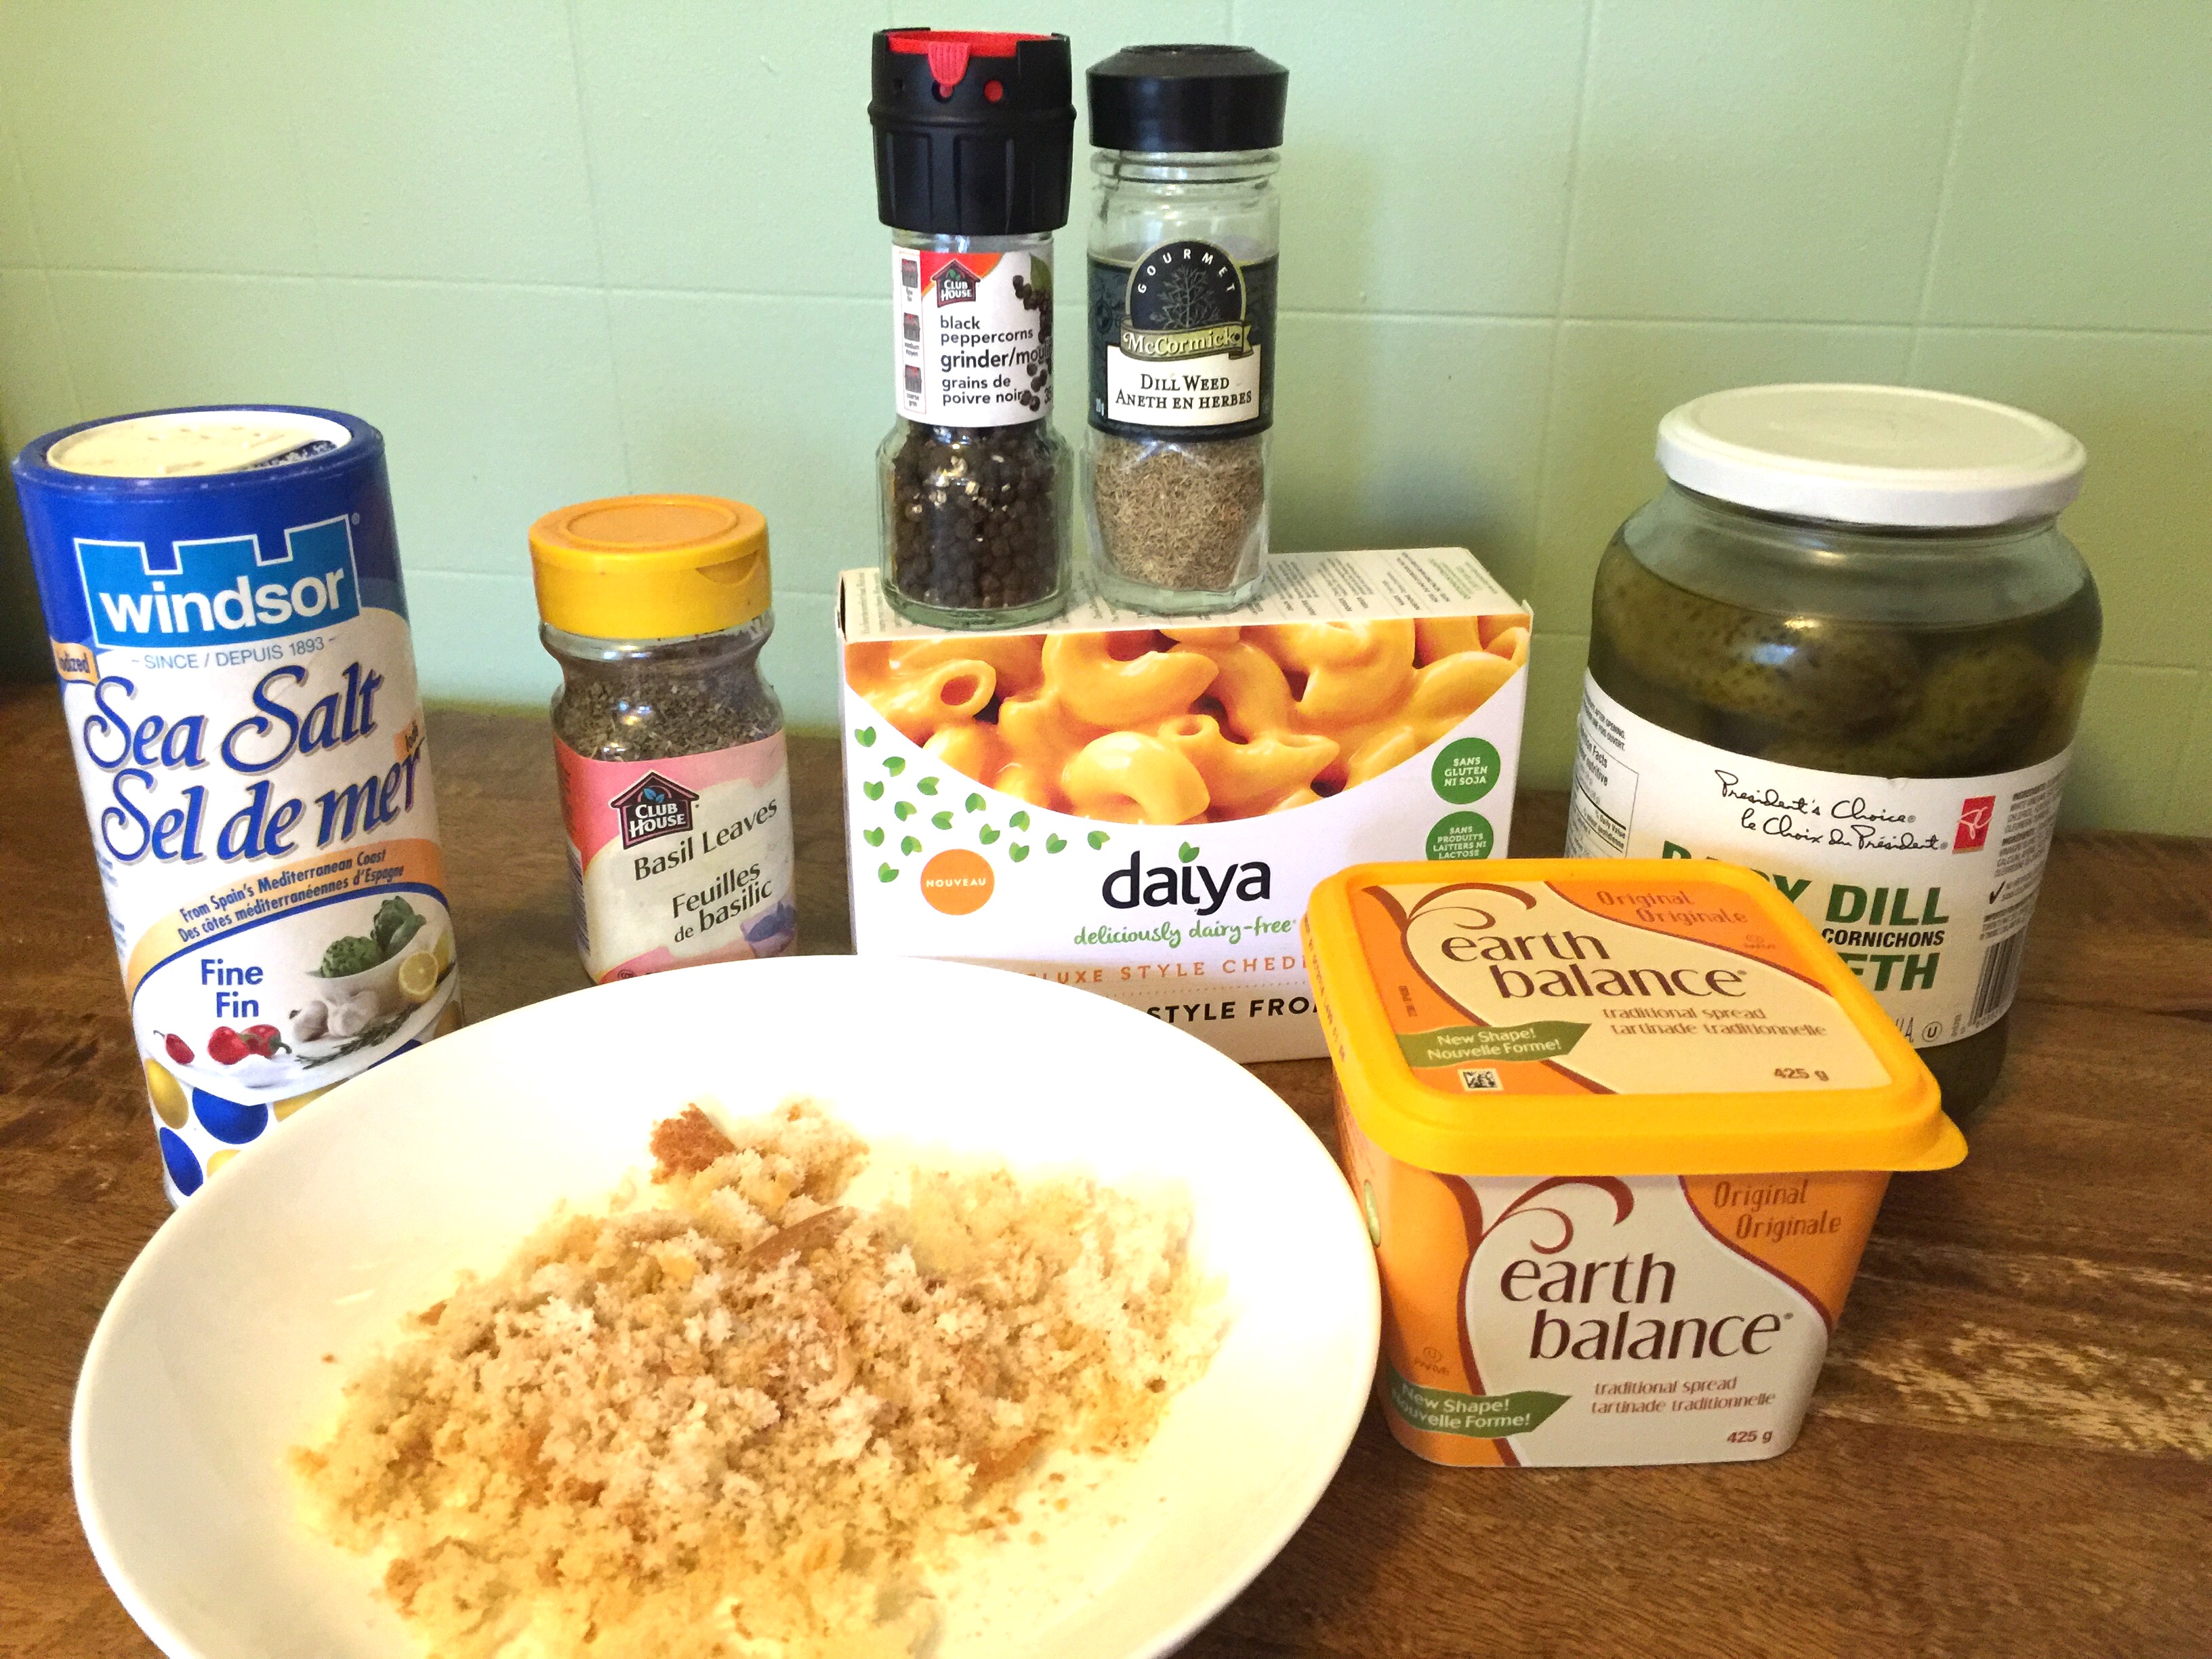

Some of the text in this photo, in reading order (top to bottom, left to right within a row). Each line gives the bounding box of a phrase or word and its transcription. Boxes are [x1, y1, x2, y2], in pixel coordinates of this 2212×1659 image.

[1138, 248, 1235, 293] GOURMET
[941, 288, 972, 302] HOUSE
[944, 279, 968, 290] CLUB
[940, 314, 981, 330] black
[941, 327, 1033, 347] peppercorns
[1123, 327, 1236, 356] McCormick
[941, 374, 1011, 392] grains de
[1141, 373, 1230, 392] DILL WEED
[943, 388, 1023, 407] poivre noir
[1115, 388, 1167, 409] ANETH
[1172, 397, 1193, 409] EN
[1199, 390, 1252, 409] HERBES
[99, 569, 344, 634] windsor
[144, 653, 197, 670] SINCE
[216, 645, 283, 668] DEPUIS
[289, 636, 325, 656] 1893
[83, 661, 382, 772] Sea Salt
[1444, 766, 1488, 777] GLUTEN
[1453, 756, 1481, 767] SANS
[1444, 776, 1486, 787] NI SOJA
[102, 737, 425, 862] Sel de mer
[1715, 769, 1906, 823] President's Choice
[636, 802, 678, 820] CLUB
[629, 815, 687, 838] HOUSE
[1449, 825, 1473, 835] SANS
[1763, 817, 1822, 843] Choix
[1851, 824, 1941, 851] Président
[634, 798, 778, 881] Basil Leaves
[1433, 840, 1487, 853] LAITIERS NI
[1437, 833, 1483, 844] PRODUITS
[1438, 849, 1480, 860] LACTOSE
[179, 848, 386, 924] From Spain's Mediterranean Coast
[926, 876, 987, 888] NOUVEAU
[1101, 842, 1271, 916] daiya
[672, 863, 761, 919] Feuilles
[1596, 889, 1696, 909] Original
[178, 865, 405, 943] Des côtes méditerranéennes d'Espagne
[674, 880, 774, 944] de basilic
[1825, 883, 1950, 926] DILL
[1635, 907, 1748, 927] Originale
[1073, 915, 1293, 949] deliciously dairy-free
[1822, 927, 1946, 949] CORNICHONS
[1441, 930, 1612, 962] earth
[200, 958, 264, 985] Fine
[1120, 961, 1205, 981] STYLE
[1223, 956, 1307, 974] CHED
[1489, 964, 1746, 1000] balance
[216, 991, 260, 1018] Fin
[1147, 996, 1317, 1024] STYLE FRO
[1602, 1007, 1767, 1020] traditional spread
[1437, 1027, 1536, 1046] New Shape!
[1610, 1023, 1828, 1036] tartinade traditionnelle
[1427, 1038, 1562, 1060] Nouvelle Forme!
[1774, 1068, 1830, 1082] 425 g
[1713, 1180, 1809, 1215] Original
[1736, 1210, 1842, 1244] Originale
[1500, 1252, 1677, 1305] earth
[1529, 1309, 1782, 1361] balance
[1595, 1376, 1738, 1396] traditional spread
[1401, 1382, 1510, 1416] New Shape!
[1591, 1390, 1777, 1414] tartinade traditionnelle
[1465, 1413, 1531, 1429] Forme!
[1726, 1430, 1774, 1445] 425 g
